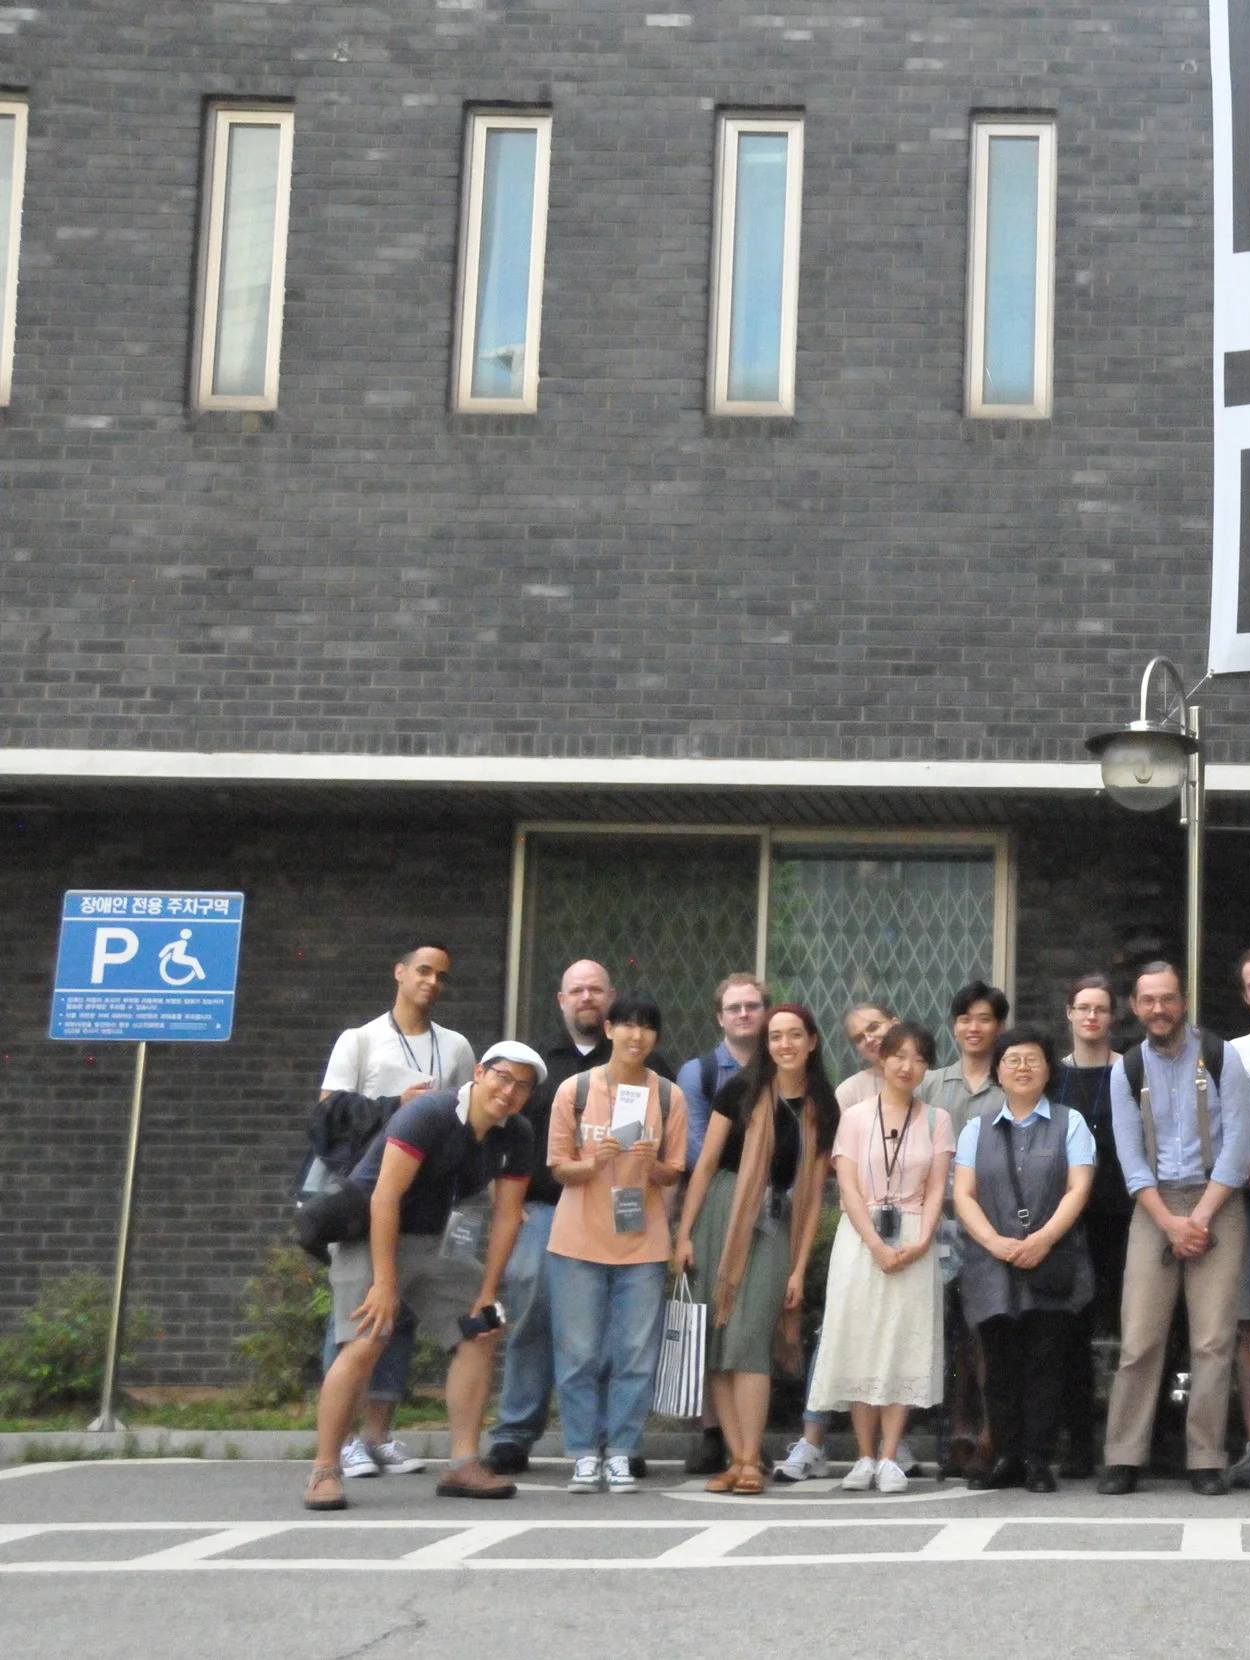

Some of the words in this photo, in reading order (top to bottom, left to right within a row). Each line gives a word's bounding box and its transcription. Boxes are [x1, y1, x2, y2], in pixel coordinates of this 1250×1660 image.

[80, 896, 127, 914] 장애인
[131, 897, 163, 915] 전용
[166, 897, 230, 916] 주차구역
[91, 927, 140, 985] P
